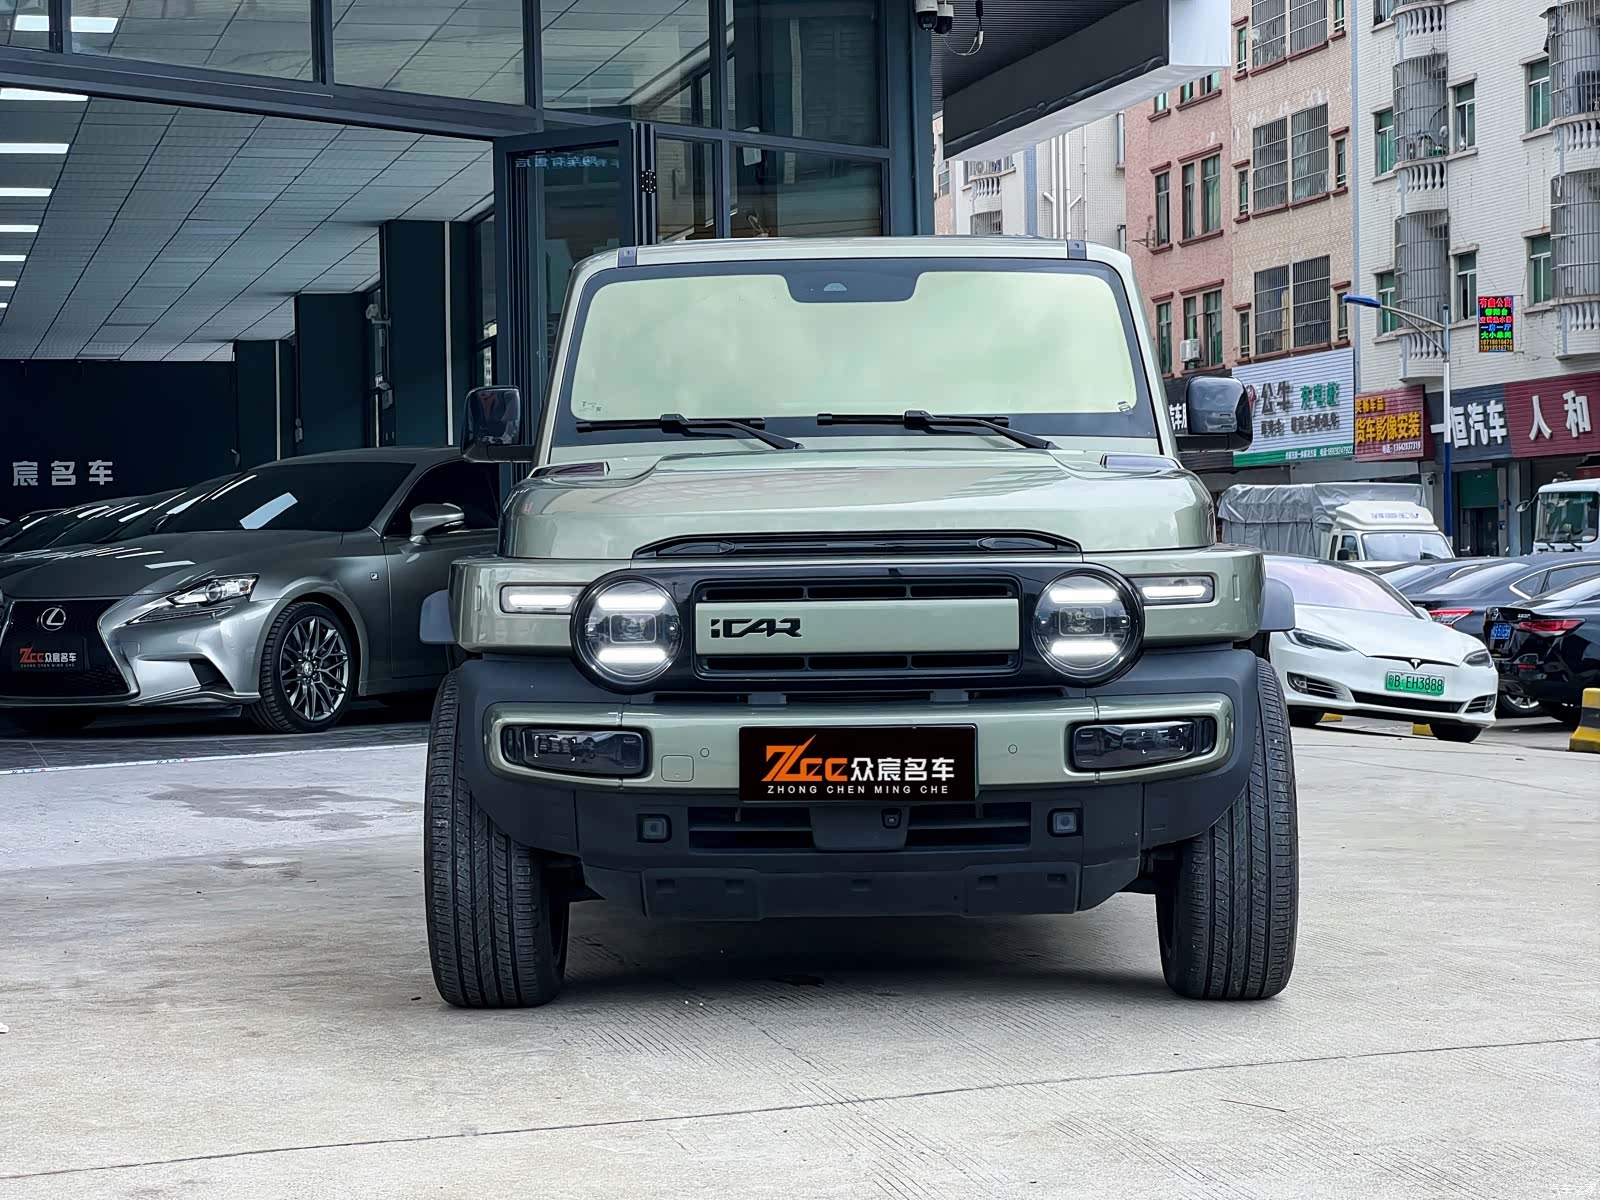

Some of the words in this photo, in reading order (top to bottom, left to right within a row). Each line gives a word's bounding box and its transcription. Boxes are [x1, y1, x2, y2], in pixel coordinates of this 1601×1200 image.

[1481, 331, 1512, 339] 大小单间
[1261, 381, 1290, 416] 公牛
[1300, 381, 1341, 411] 充电桩
[1356, 412, 1420, 444] 货车影像安装
[1529, 390, 1591, 441] 人和
[13, 460, 113, 486] 宸名车
[850, 757, 955, 782] 众宸名车
[767, 785, 818, 794] ZHONG
[826, 785, 865, 794] CHEN
[874, 785, 911, 794] MING
[920, 785, 949, 794] CHE
